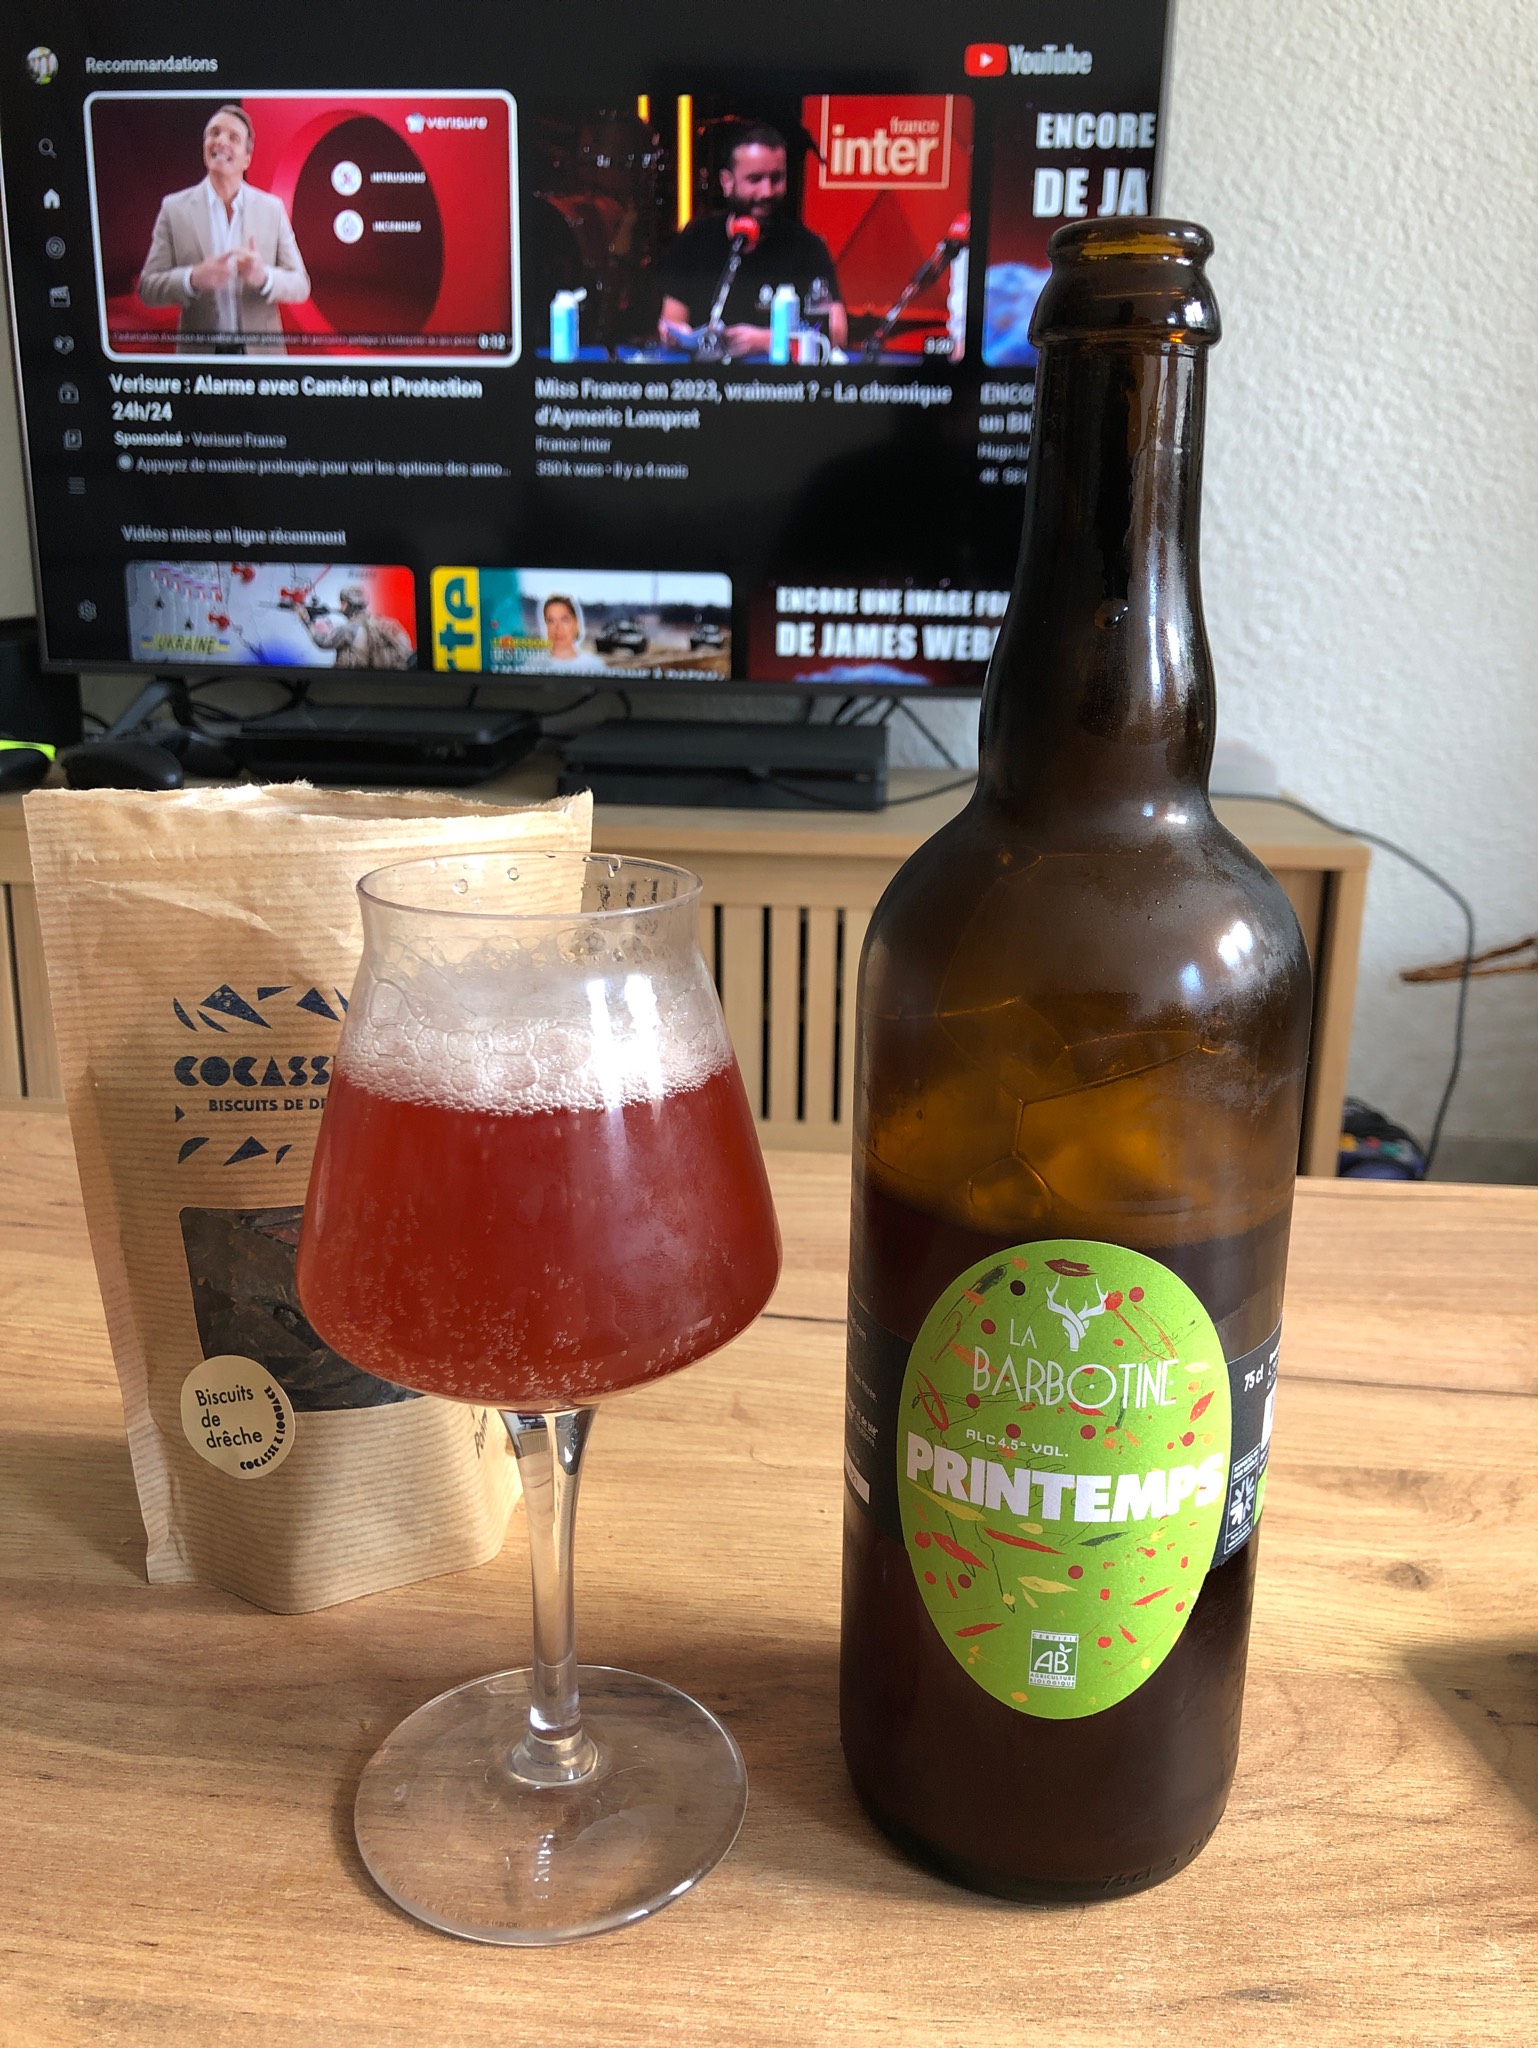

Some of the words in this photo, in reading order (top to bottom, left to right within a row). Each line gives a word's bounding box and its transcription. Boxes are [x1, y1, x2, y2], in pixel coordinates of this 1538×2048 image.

[85, 55, 218, 73] Recommandations
[1008, 43, 1093, 75] YouTube
[426, 116, 488, 130] verisure
[890, 116, 939, 134] france
[1036, 112, 1156, 149] ENCORE
[831, 124, 939, 175] inter
[1033, 168, 1090, 217] DE
[1097, 168, 1150, 217] JA
[109, 373, 182, 394] Verisure
[194, 374, 256, 395] Alarme
[257, 378, 299, 396] avec
[301, 375, 369, 397] Caméra
[370, 376, 390, 397] et
[391, 376, 483, 398] Protection
[534, 376, 579, 399] Miss
[580, 377, 643, 400] France
[644, 381, 669, 400] en
[670, 378, 722, 405] 2023,
[724, 378, 805, 402] vraiment
[833, 379, 858, 403] La
[859, 379, 953, 409] chronique
[112, 401, 173, 422] 24h/24
[191, 432, 243, 448] Verisure
[244, 432, 287, 449] France
[135, 457, 188, 475] Appuyez
[189, 457, 206, 474] de
[120, 524, 169, 543] Vidéos
[169, 526, 212, 544] mises
[212, 528, 231, 544] en
[231, 525, 267, 548] ligne
[267, 527, 347, 547] récemment
[775, 586, 859, 615] ENCORE
[859, 587, 902, 616] UNE
[903, 588, 973, 618] IMAGE
[157, 636, 215, 654] UKRAINE
[775, 621, 815, 657] DE
[818, 622, 918, 660] JAMES
[921, 624, 1001, 661] WEB
[174, 1056, 336, 1086] COCASS
[208, 1099, 278, 1112] BISCUITS
[284, 1099, 303, 1110] DE
[1009, 1318, 1037, 1349] LA
[973, 1345, 1179, 1409] BARBOTINE
[195, 1384, 254, 1406] Biscuits
[201, 1408, 221, 1428] de
[206, 1426, 263, 1448] drêche
[966, 1428, 996, 1446] ALC
[1031, 1442, 1069, 1457] VOL.
[240, 1443, 280, 1470] COCASSE
[906, 1431, 1225, 1523] PRINTEMPS
[1034, 1650, 1069, 1673] AB
[1030, 1673, 1075, 1681] AGRICULTURE
